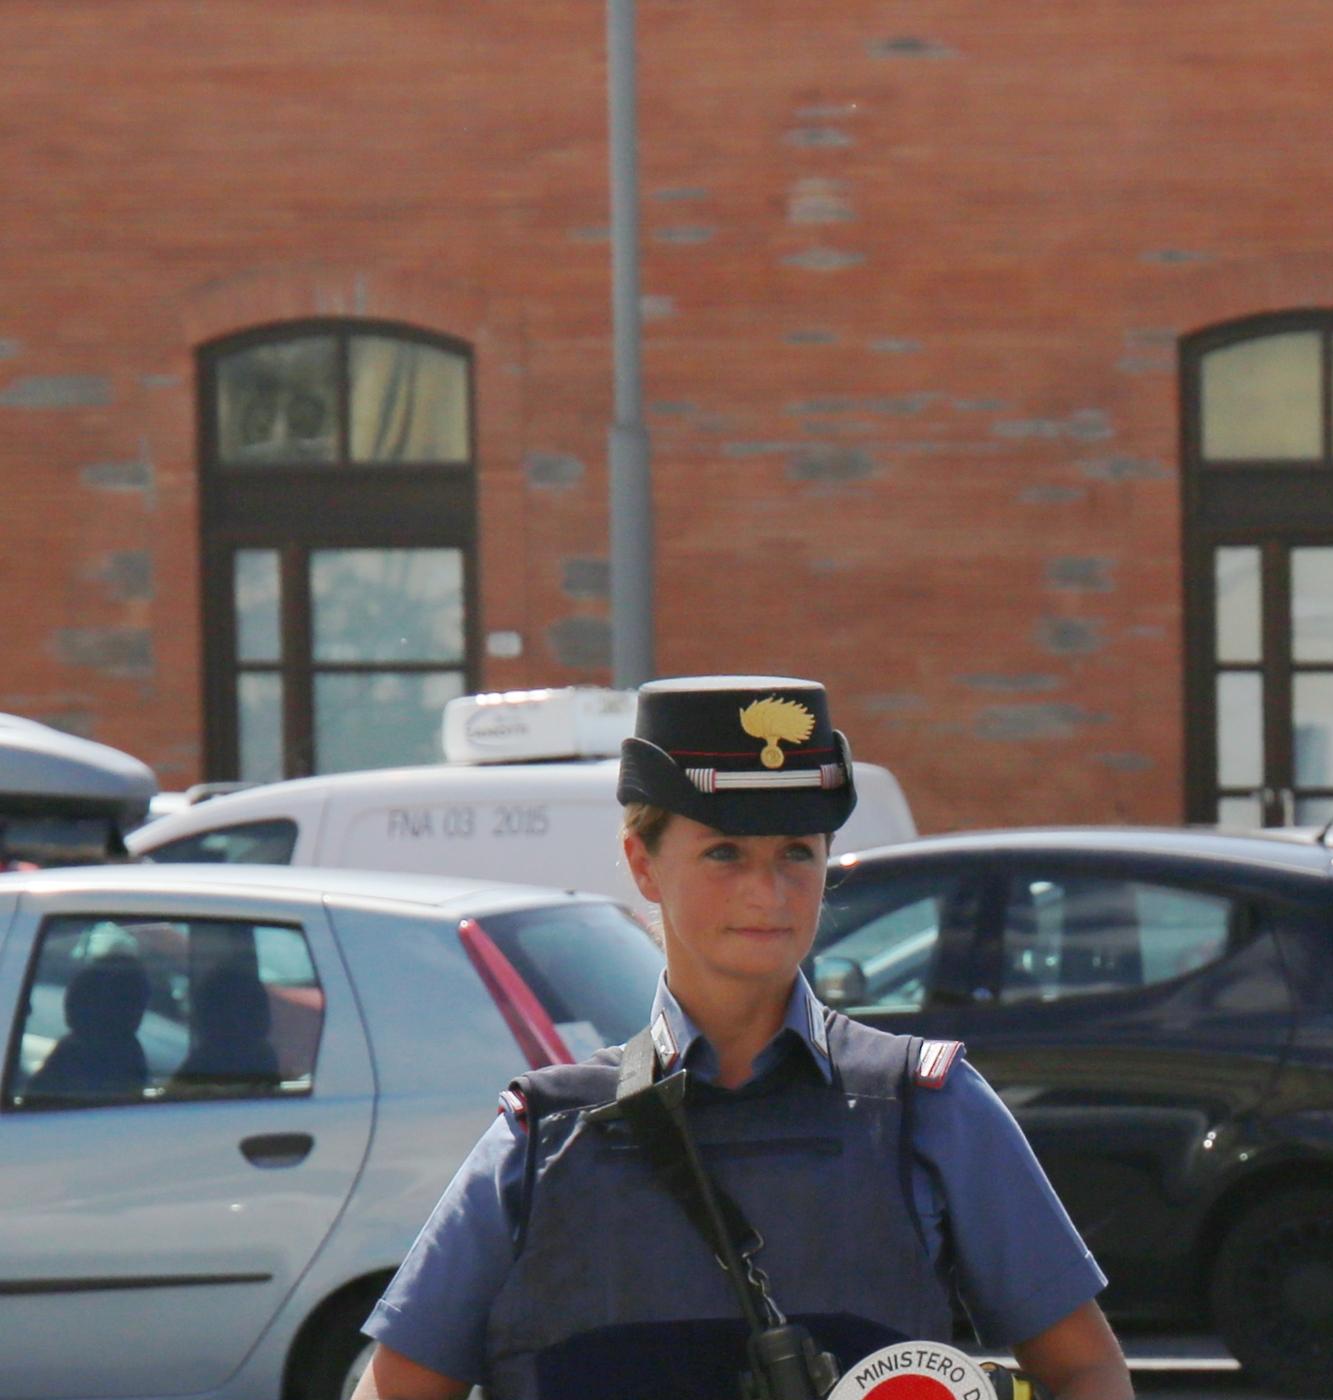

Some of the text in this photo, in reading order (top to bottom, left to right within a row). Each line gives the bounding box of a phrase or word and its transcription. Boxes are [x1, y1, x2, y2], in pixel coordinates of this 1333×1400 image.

[387, 804, 550, 838] FNA 03 2015
[855, 1351, 965, 1389] MINISTERO
